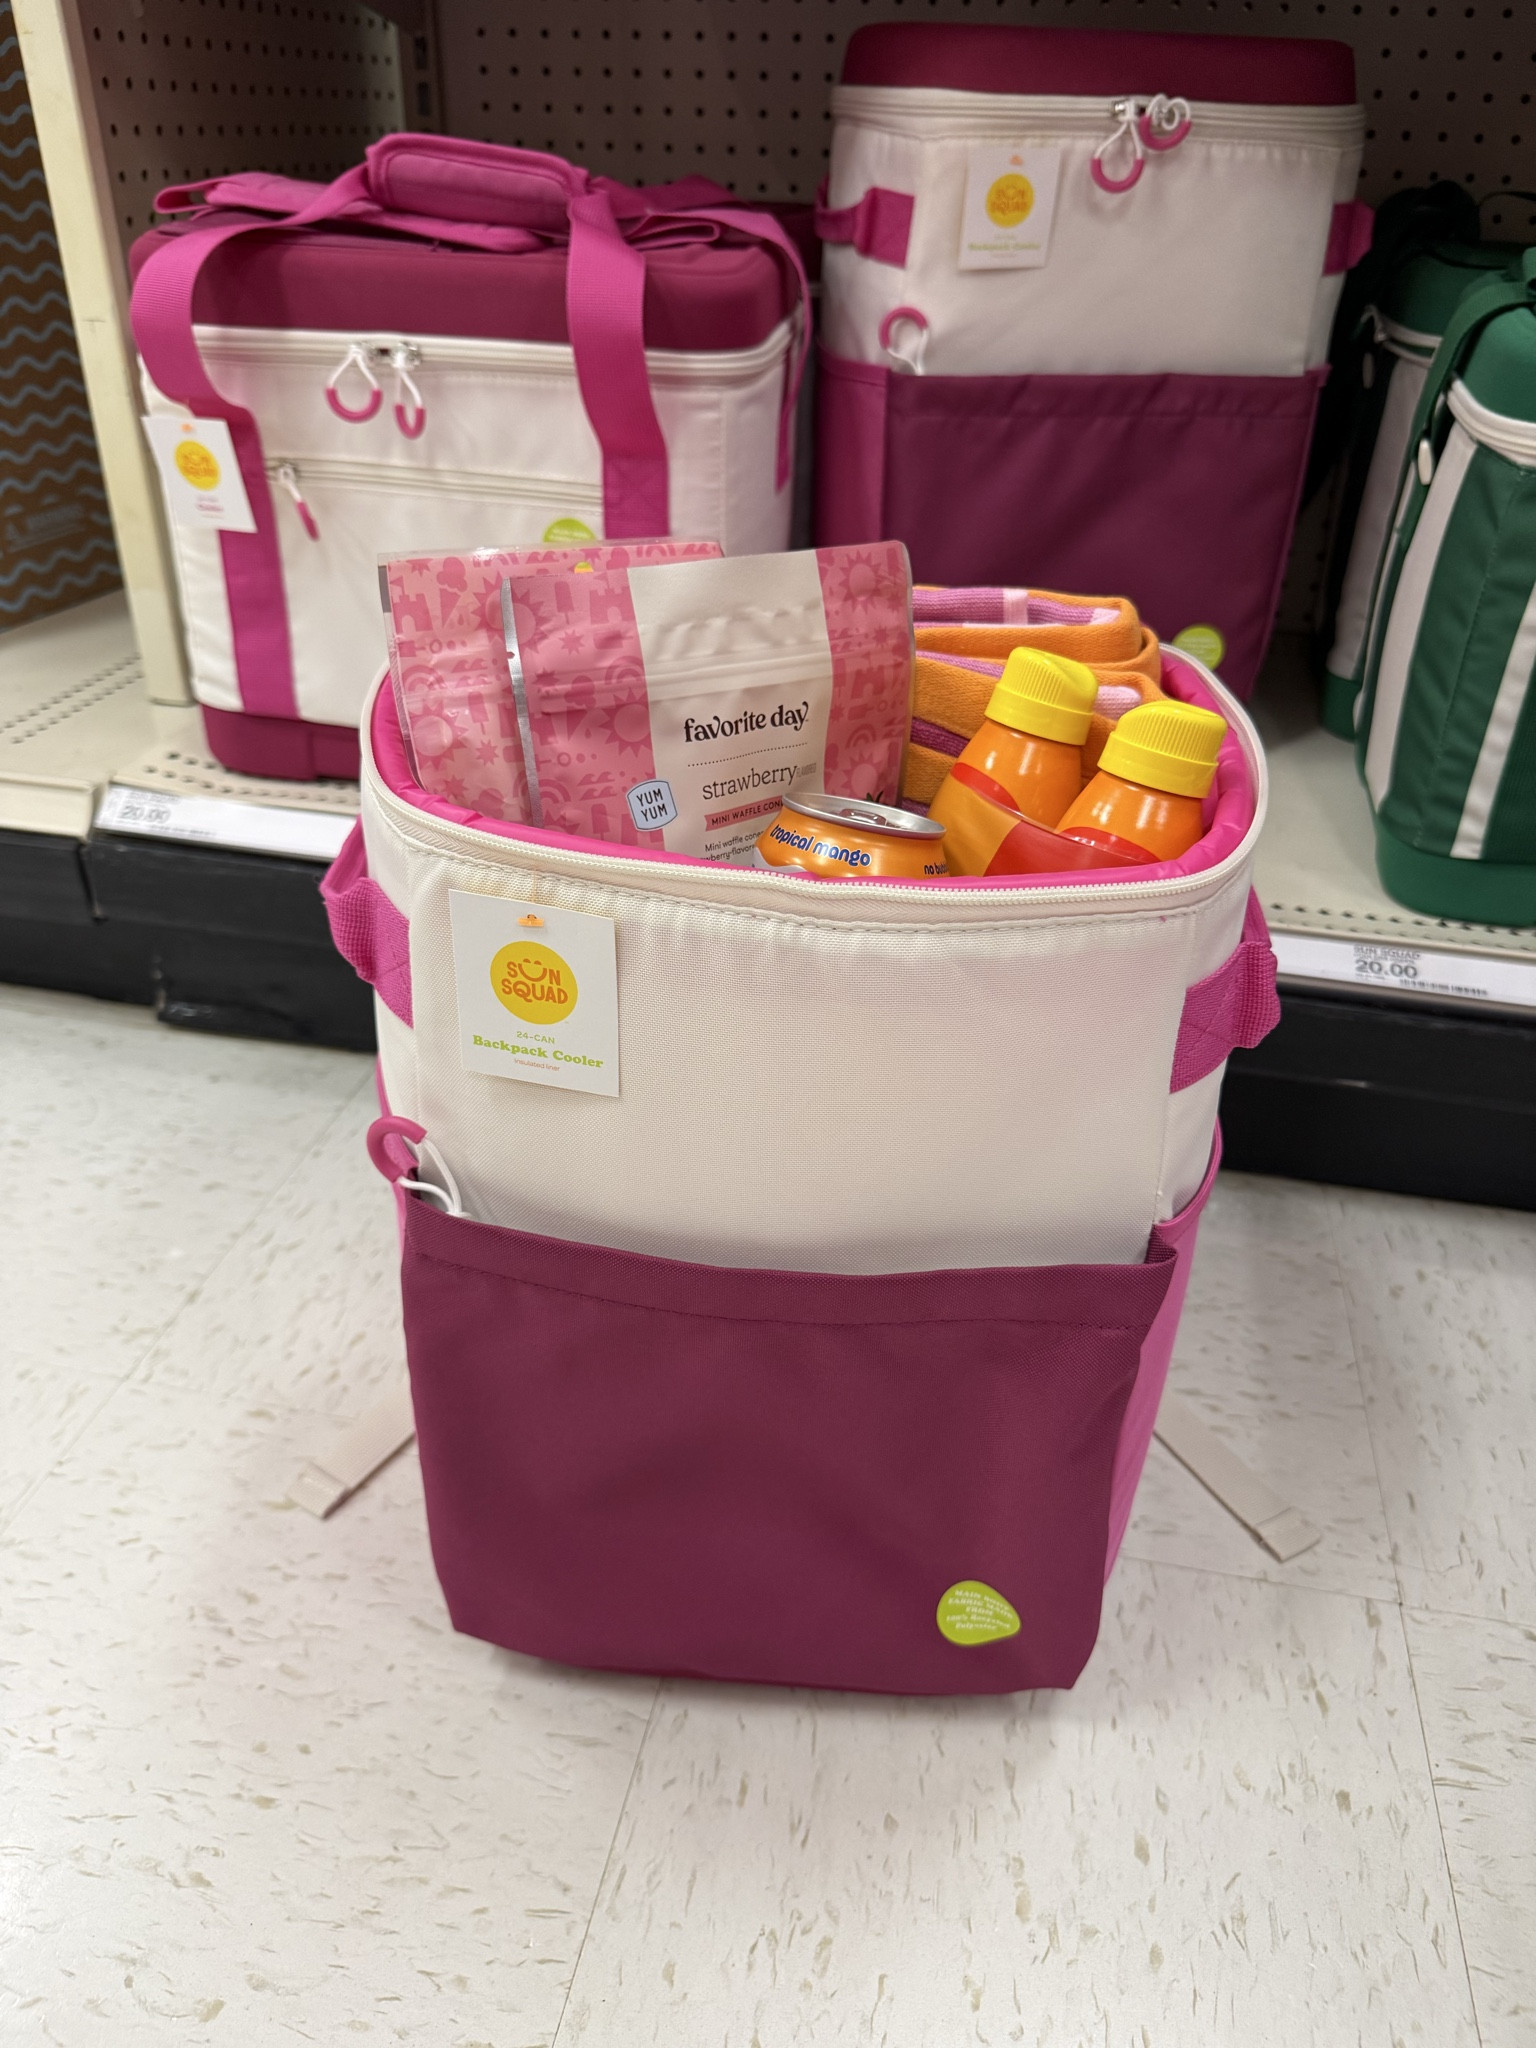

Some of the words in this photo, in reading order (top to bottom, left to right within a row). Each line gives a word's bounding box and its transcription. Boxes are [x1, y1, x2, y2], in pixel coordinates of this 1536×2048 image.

[684, 711, 767, 742] favorite
[770, 701, 809, 731] day
[702, 765, 798, 800] strawberry
[636, 788, 663, 807] YUM
[641, 804, 668, 822] YUM
[711, 815, 730, 826] MINI
[733, 804, 762, 820] WAFFLE
[705, 841, 722, 853] Mini
[722, 836, 743, 848] waffle
[769, 823, 814, 852] tropical
[813, 840, 871, 866] mango
[924, 864, 935, 875] no
[507, 959, 561, 986] SUN
[1354, 959, 1419, 978] 20.00
[501, 978, 569, 1004] SQUAD
[516, 1031, 556, 1045] 24-CAN
[472, 1034, 548, 1059] Backpack
[552, 1050, 604, 1069] Cooler
[514, 1058, 546, 1070] insulated
[545, 1063, 561, 1072] liner
